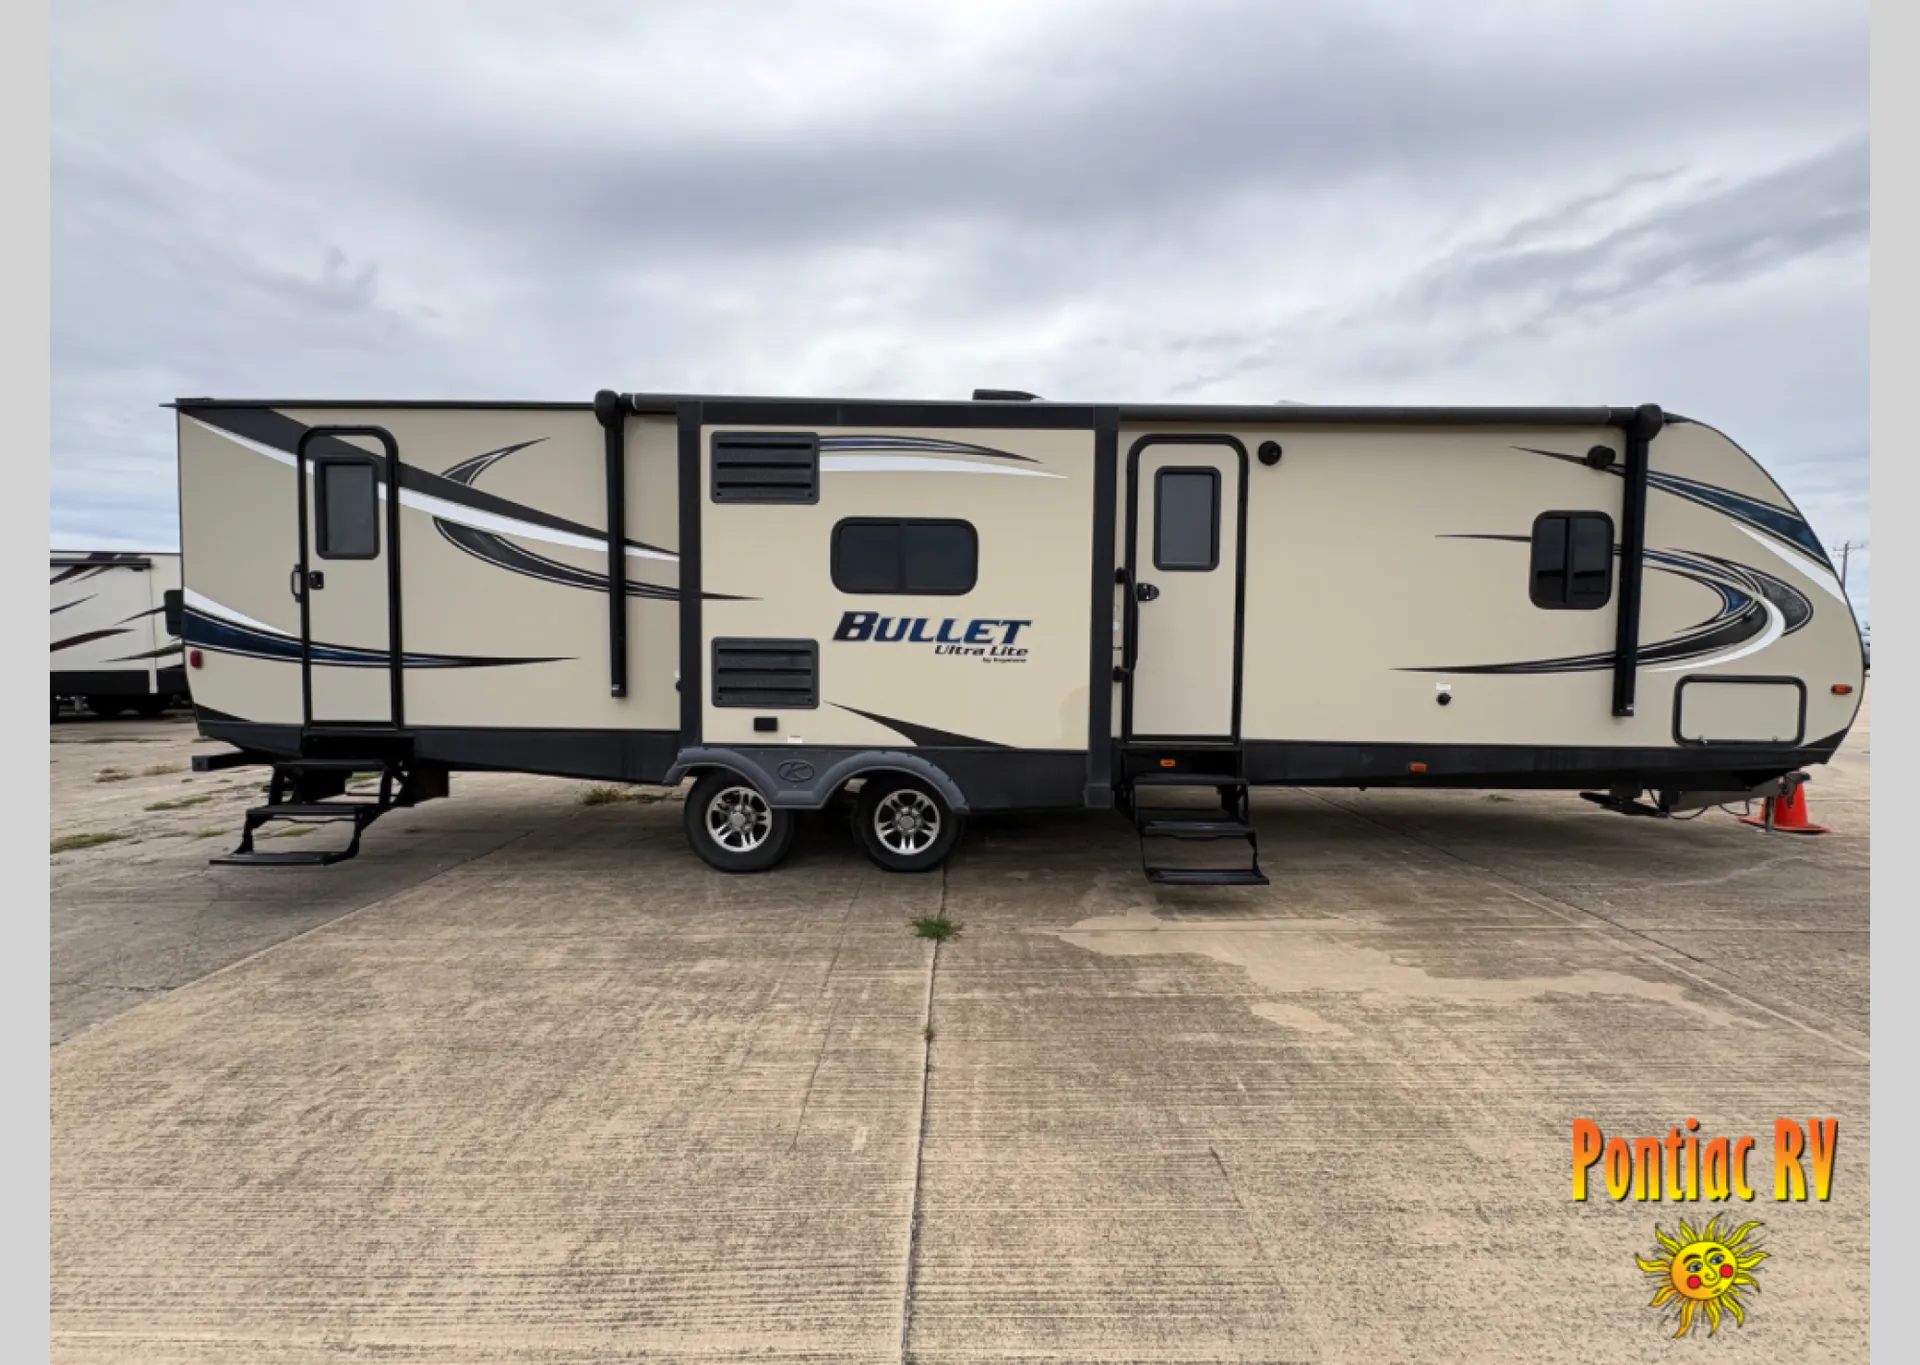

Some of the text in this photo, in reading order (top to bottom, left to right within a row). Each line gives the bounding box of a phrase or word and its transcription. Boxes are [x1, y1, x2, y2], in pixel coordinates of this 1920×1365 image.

[832, 611, 1032, 644] BULLET
[934, 644, 1029, 657] Ultra Lite
